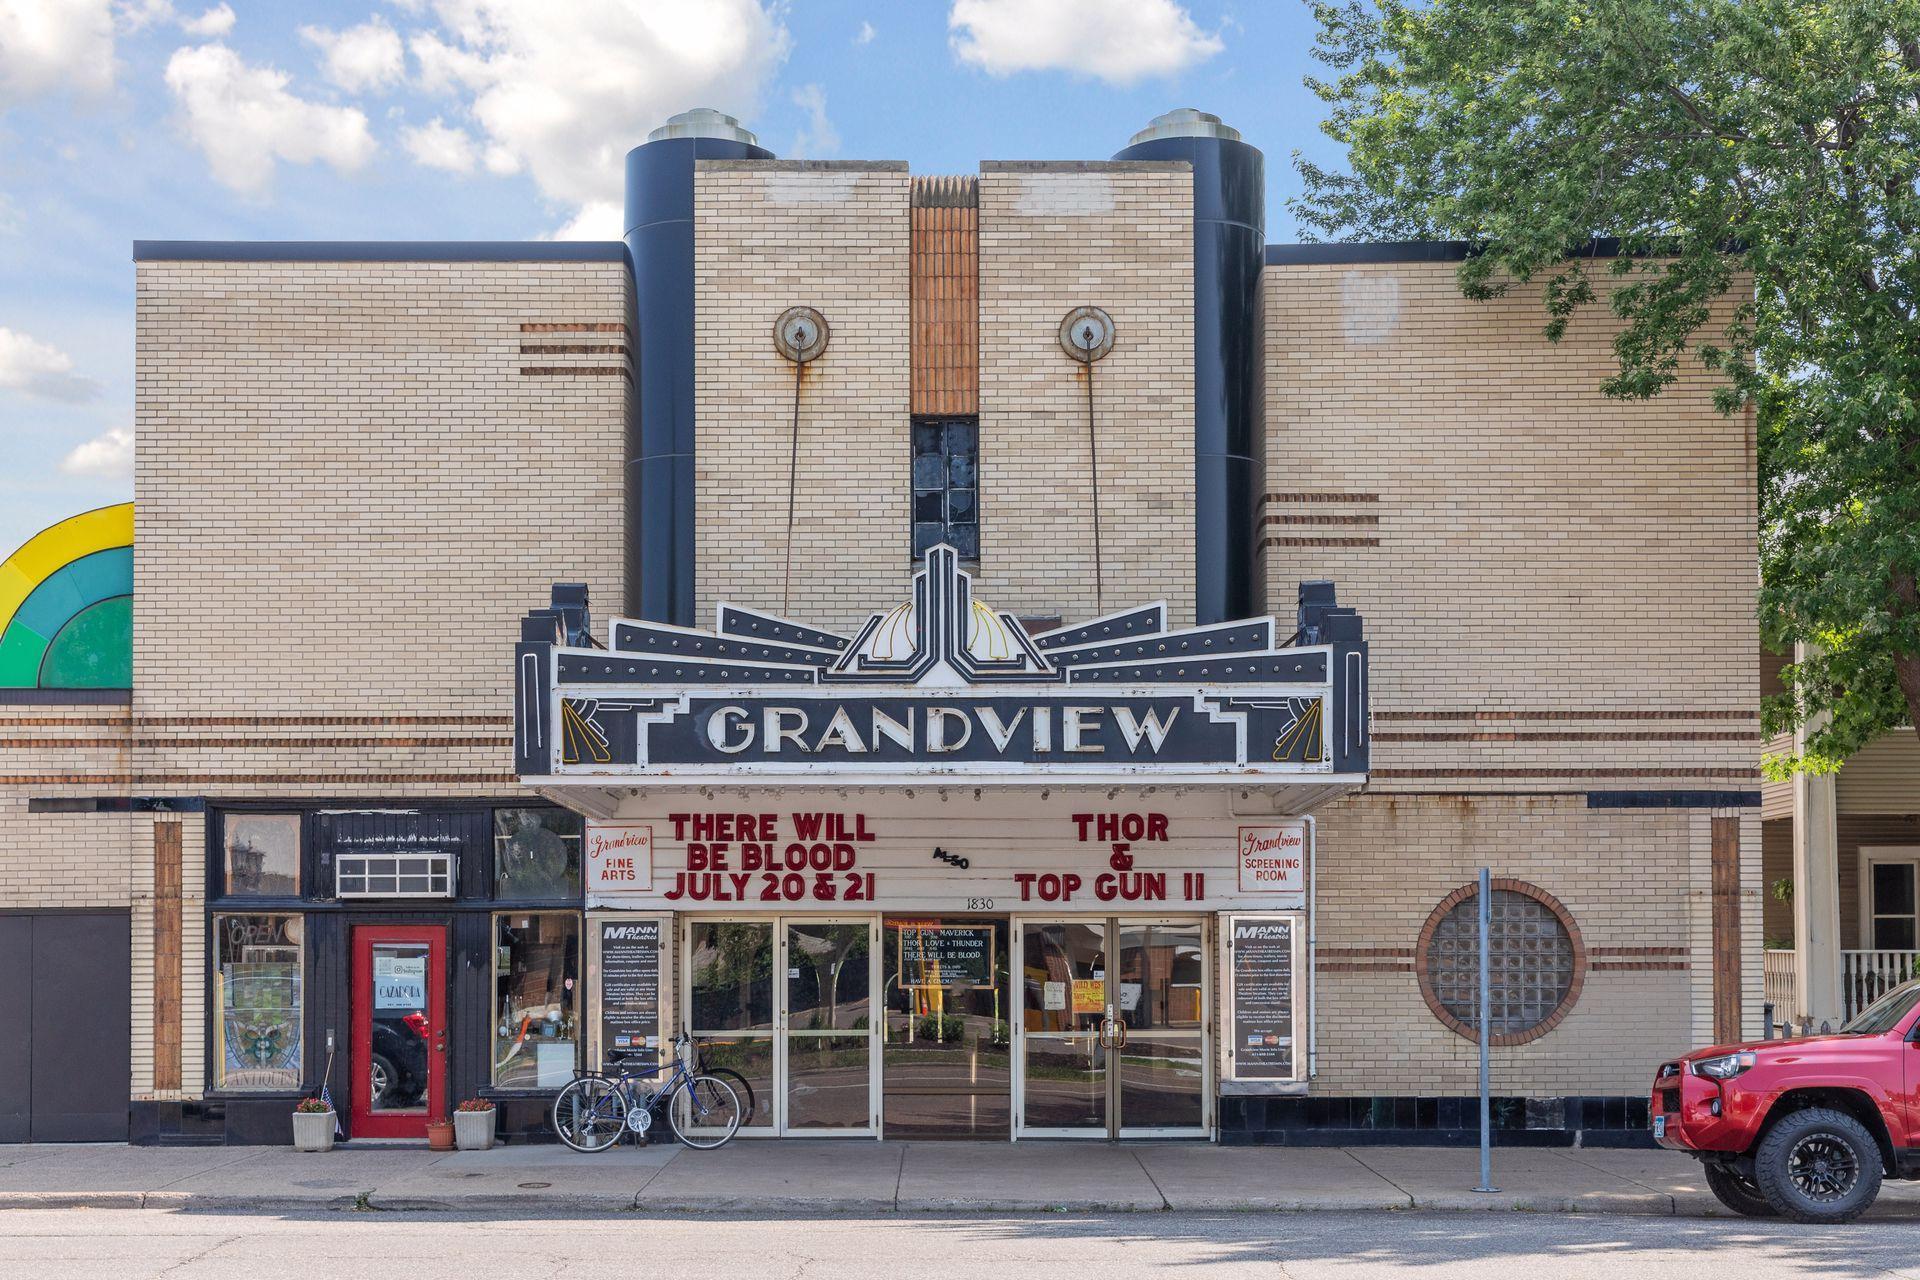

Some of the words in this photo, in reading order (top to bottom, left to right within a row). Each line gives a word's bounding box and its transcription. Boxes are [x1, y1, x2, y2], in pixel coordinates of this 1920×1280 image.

[707, 704, 1181, 754] GRANDVIEW
[668, 813, 778, 841] THERE
[792, 812, 876, 841] WILL
[1072, 813, 1169, 841] THOR
[590, 831, 648, 858] Grandview
[1242, 831, 1301, 856] Grandview
[606, 859, 633, 868] FINE
[687, 843, 729, 871] BE
[741, 843, 856, 871] BLOOD
[1110, 843, 1133, 871] &
[1245, 858, 1299, 868] SCREENING
[601, 870, 635, 880] ARTS
[664, 873, 752, 901] JULY
[760, 873, 805, 901] 20
[813, 873, 836, 901] &
[843, 873, 875, 901] 21
[1014, 873, 1082, 901] TOP
[1095, 873, 1166, 901] GUN
[1184, 873, 1204, 900] II
[967, 898, 994, 910] 1830
[231, 924, 283, 944] OPEN
[604, 927, 658, 939] MANN
[940, 929, 974, 937] MAVERICK
[1235, 926, 1290, 938] MANN
[958, 951, 981, 959] BLOOD
[231, 1071, 294, 1087] ANTIQUES
